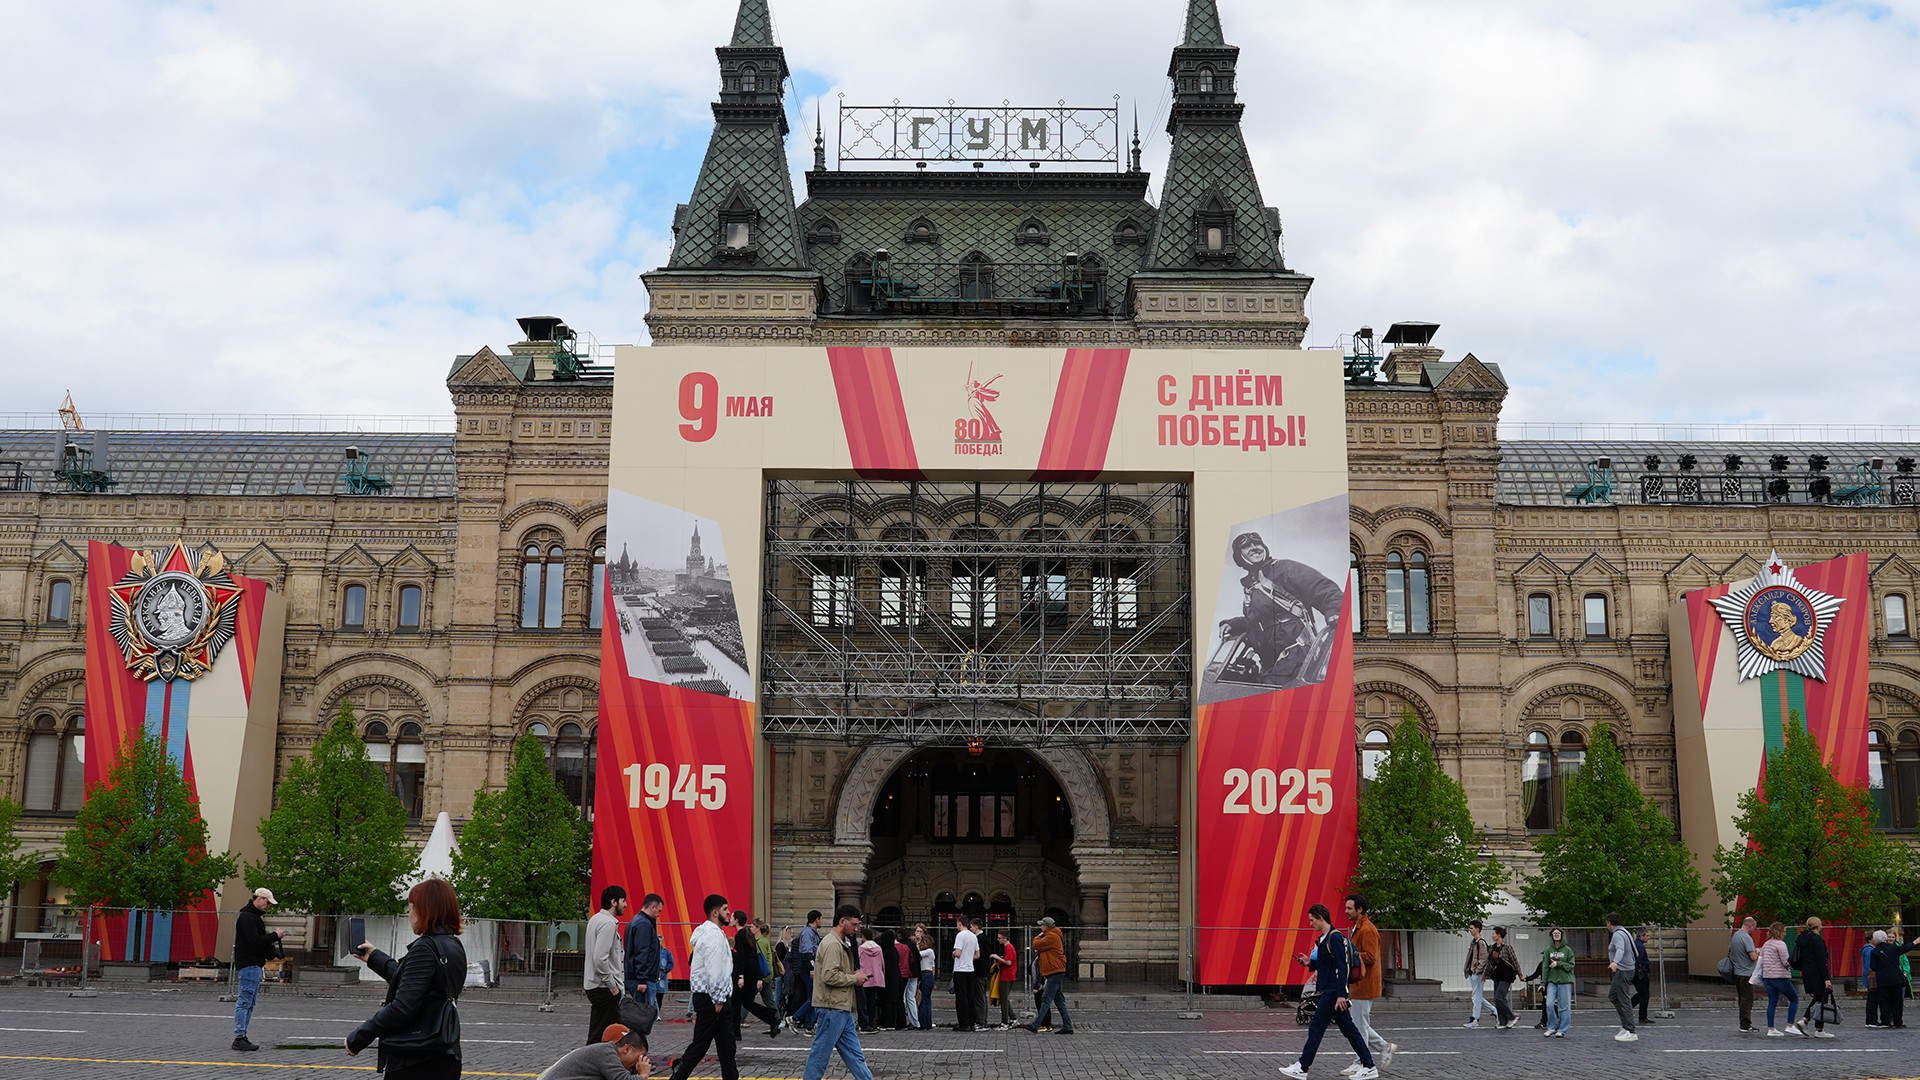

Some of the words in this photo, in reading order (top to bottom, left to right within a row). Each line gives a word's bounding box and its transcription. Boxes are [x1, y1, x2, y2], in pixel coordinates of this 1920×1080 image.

[912, 117, 1047, 150] ГУМ
[678, 371, 719, 443] 9
[726, 396, 774, 417] МАЯ
[1157, 374, 1177, 406] С
[1189, 369, 1283, 411] ДНЁМ
[955, 418, 980, 440] 80
[1158, 414, 1307, 451] ПОБЕДЫ!
[954, 443, 1003, 456] ПОБЕДА!
[142, 581, 168, 633] АЛЕКСАНДР
[180, 581, 203, 624] НЕВСКИЙ
[1750, 591, 1785, 625] АЛЕКСАНДР
[1786, 593, 1812, 626] СУВОРОВ
[623, 763, 727, 810] 1945
[1223, 768, 1334, 815] 2025
